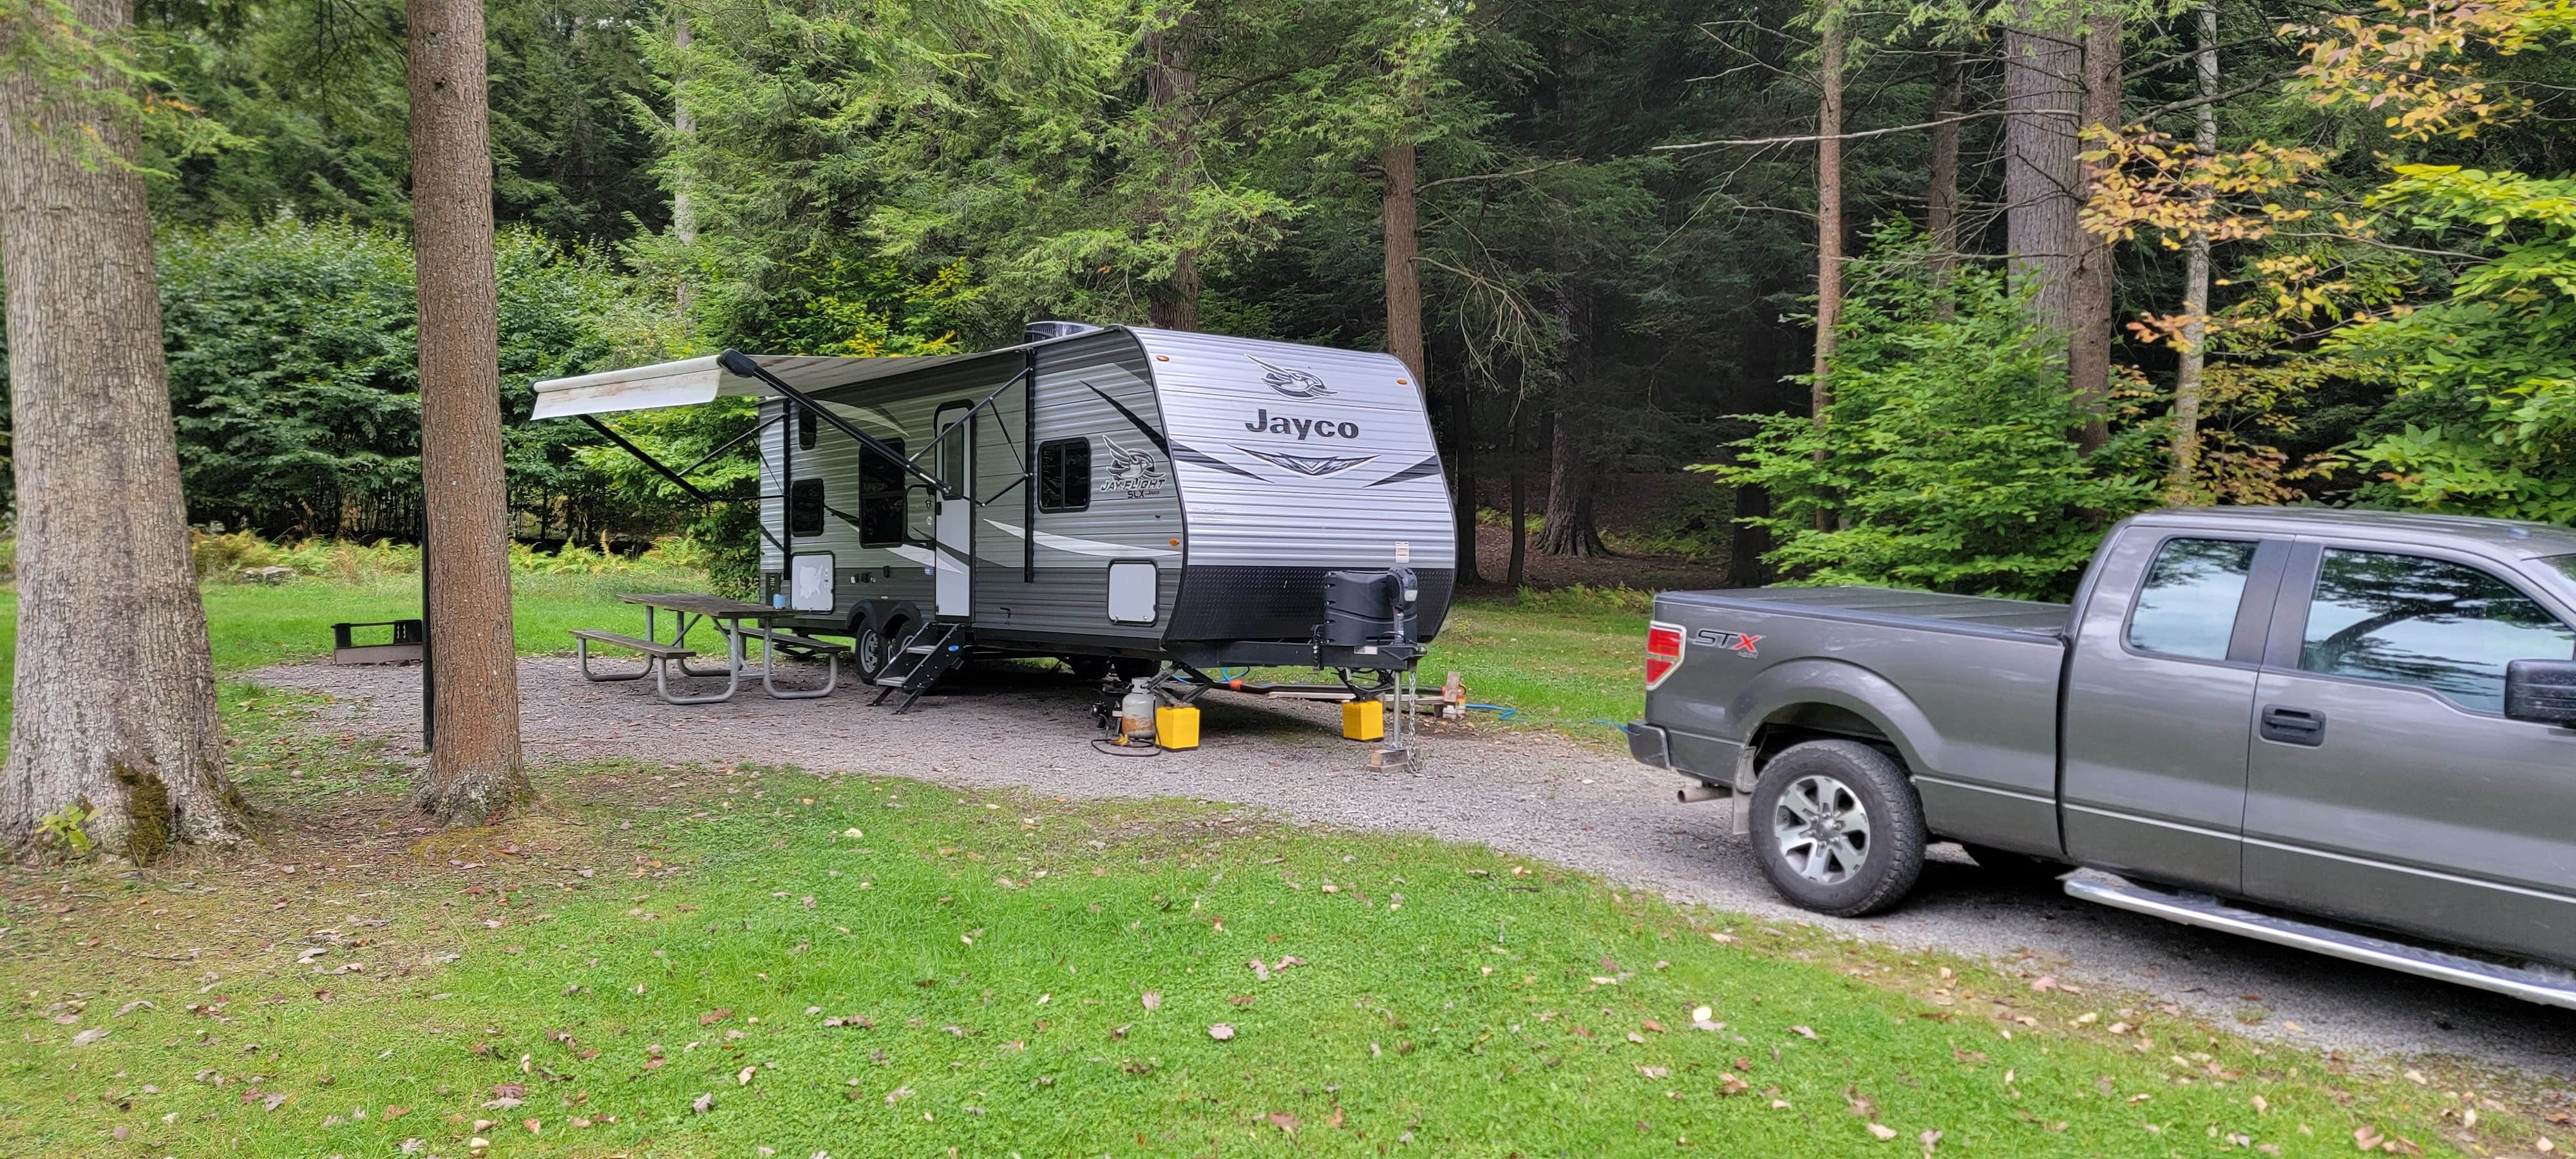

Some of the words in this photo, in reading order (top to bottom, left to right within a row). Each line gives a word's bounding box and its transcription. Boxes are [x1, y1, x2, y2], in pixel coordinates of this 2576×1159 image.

[1245, 409, 1359, 440] Jayco
[1128, 490, 1144, 498] SLX
[1694, 629, 1764, 652] STX
